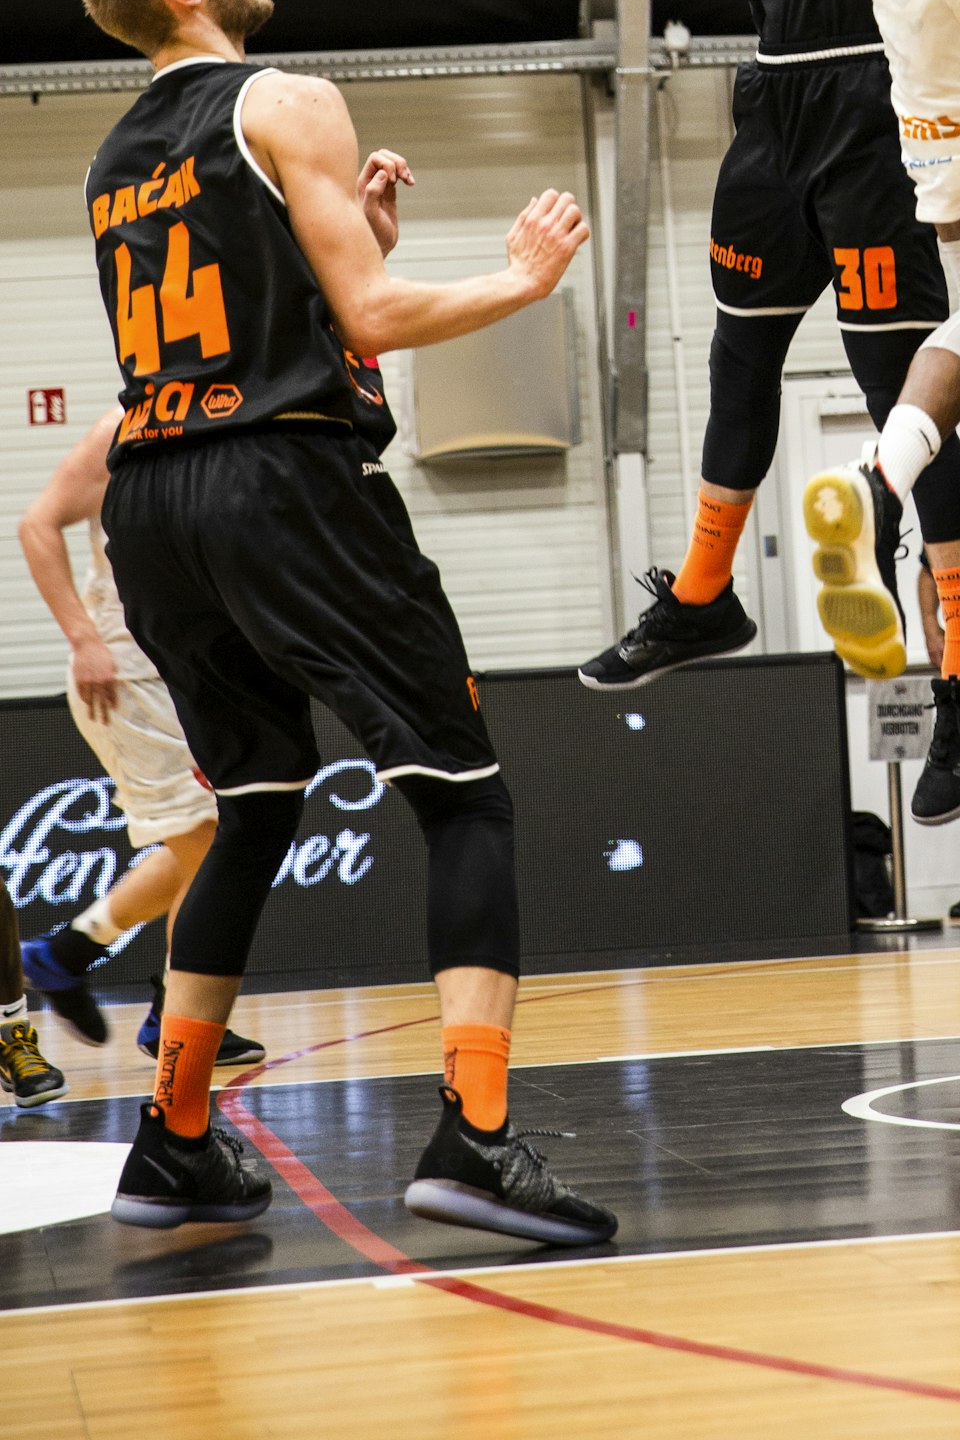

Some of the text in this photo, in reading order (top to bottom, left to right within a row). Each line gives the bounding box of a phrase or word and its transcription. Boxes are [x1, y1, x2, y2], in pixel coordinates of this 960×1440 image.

[115, 220, 232, 378] 44
[833, 246, 898, 311] 30
[161, 426, 184, 440] you
